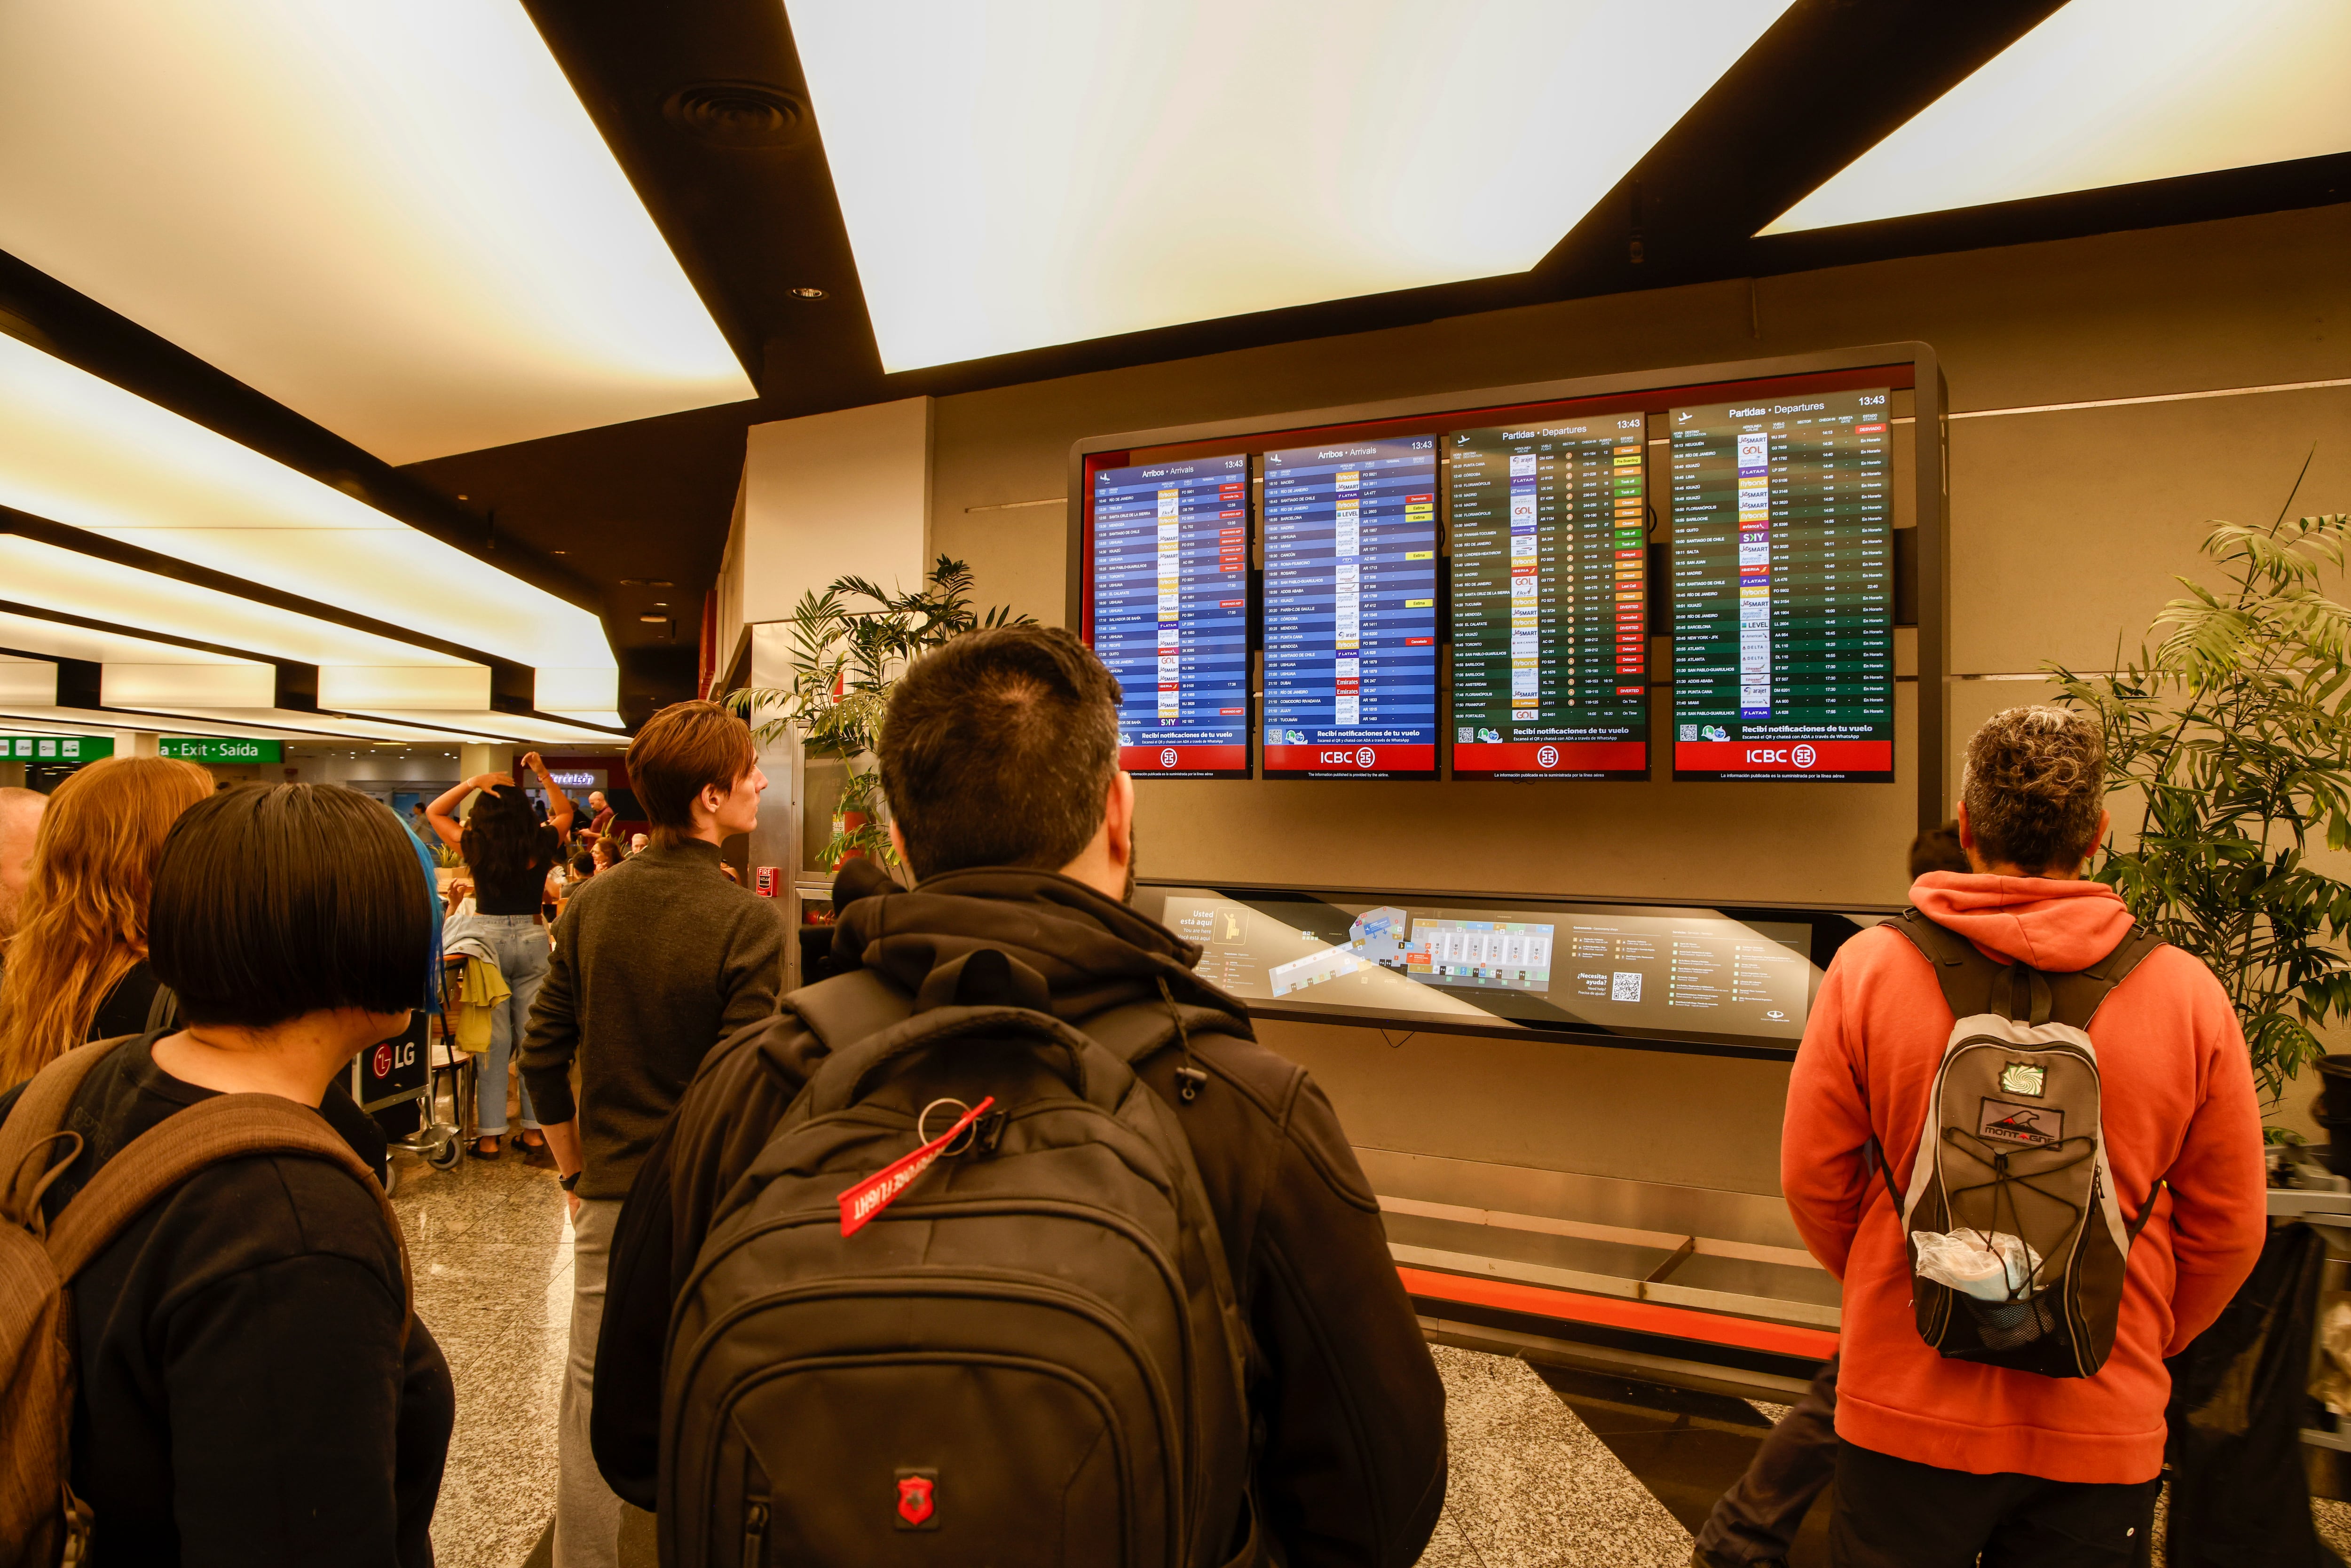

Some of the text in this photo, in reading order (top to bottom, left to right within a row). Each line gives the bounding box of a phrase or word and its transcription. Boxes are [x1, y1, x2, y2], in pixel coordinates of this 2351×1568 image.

[1859, 395, 1885, 406] 13:43
[1729, 402, 1824, 418] Partidas Departures
[1617, 419, 1640, 429] 13:43
[1503, 425, 1587, 440] Partidas Departures
[1412, 441, 1432, 450] 13:43
[1743, 446, 1762, 455] GOL
[1318, 447, 1376, 459] Arribos Arrivals
[1225, 460, 1243, 468] 13:43
[1142, 470, 1164, 478] Arribos
[181, 743, 208, 756] Exit
[219, 743, 259, 756] Saída
[1321, 752, 1352, 764] ICBC
[1747, 749, 1787, 763] ICBC
[394, 1042, 415, 1069] LG
